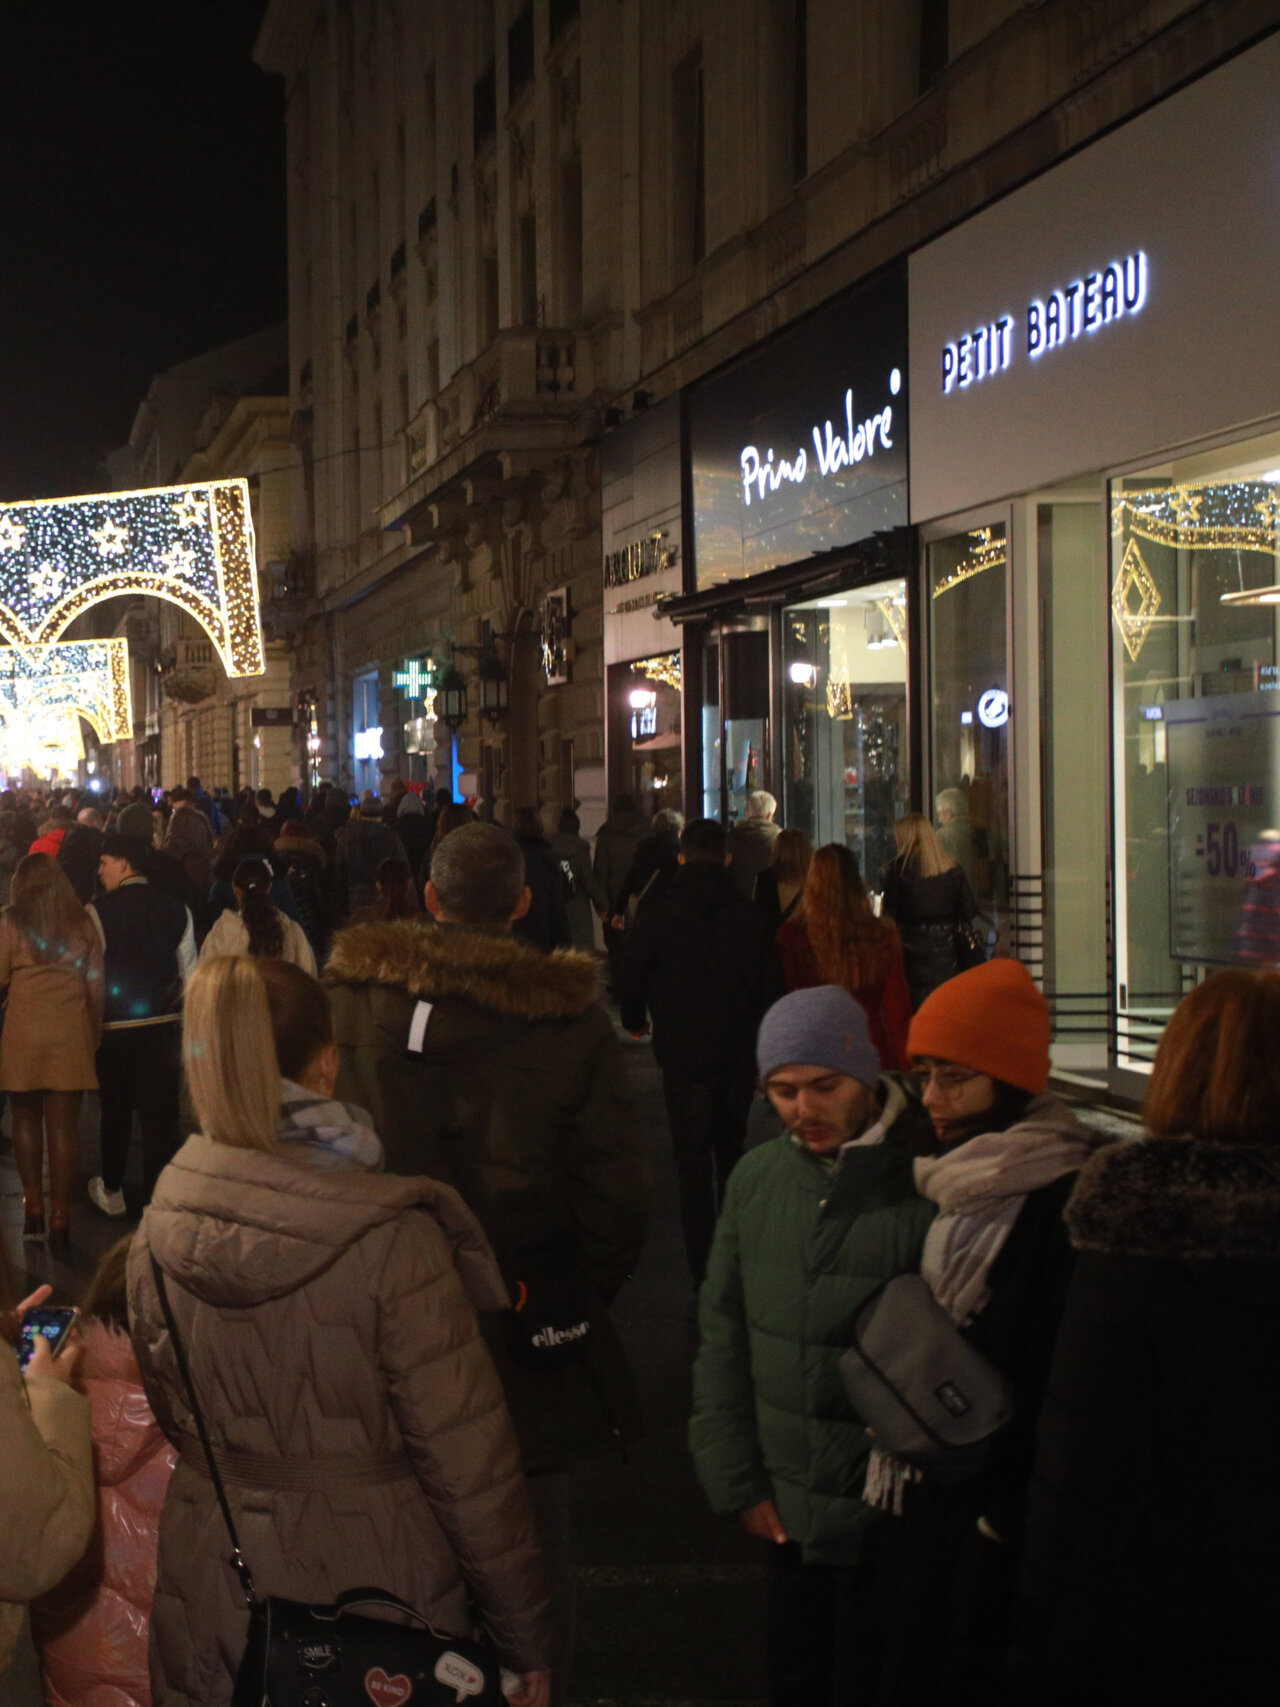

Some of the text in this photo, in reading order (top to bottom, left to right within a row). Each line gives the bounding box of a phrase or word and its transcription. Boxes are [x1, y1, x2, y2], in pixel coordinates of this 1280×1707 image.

[942, 250, 1147, 394] PETIT BATEAU
[812, 388, 893, 477] Valore
[531, 1321, 590, 1348] ellesse
[303, 1645, 332, 1659] SMILE
[371, 1680, 405, 1697] BE KIND
